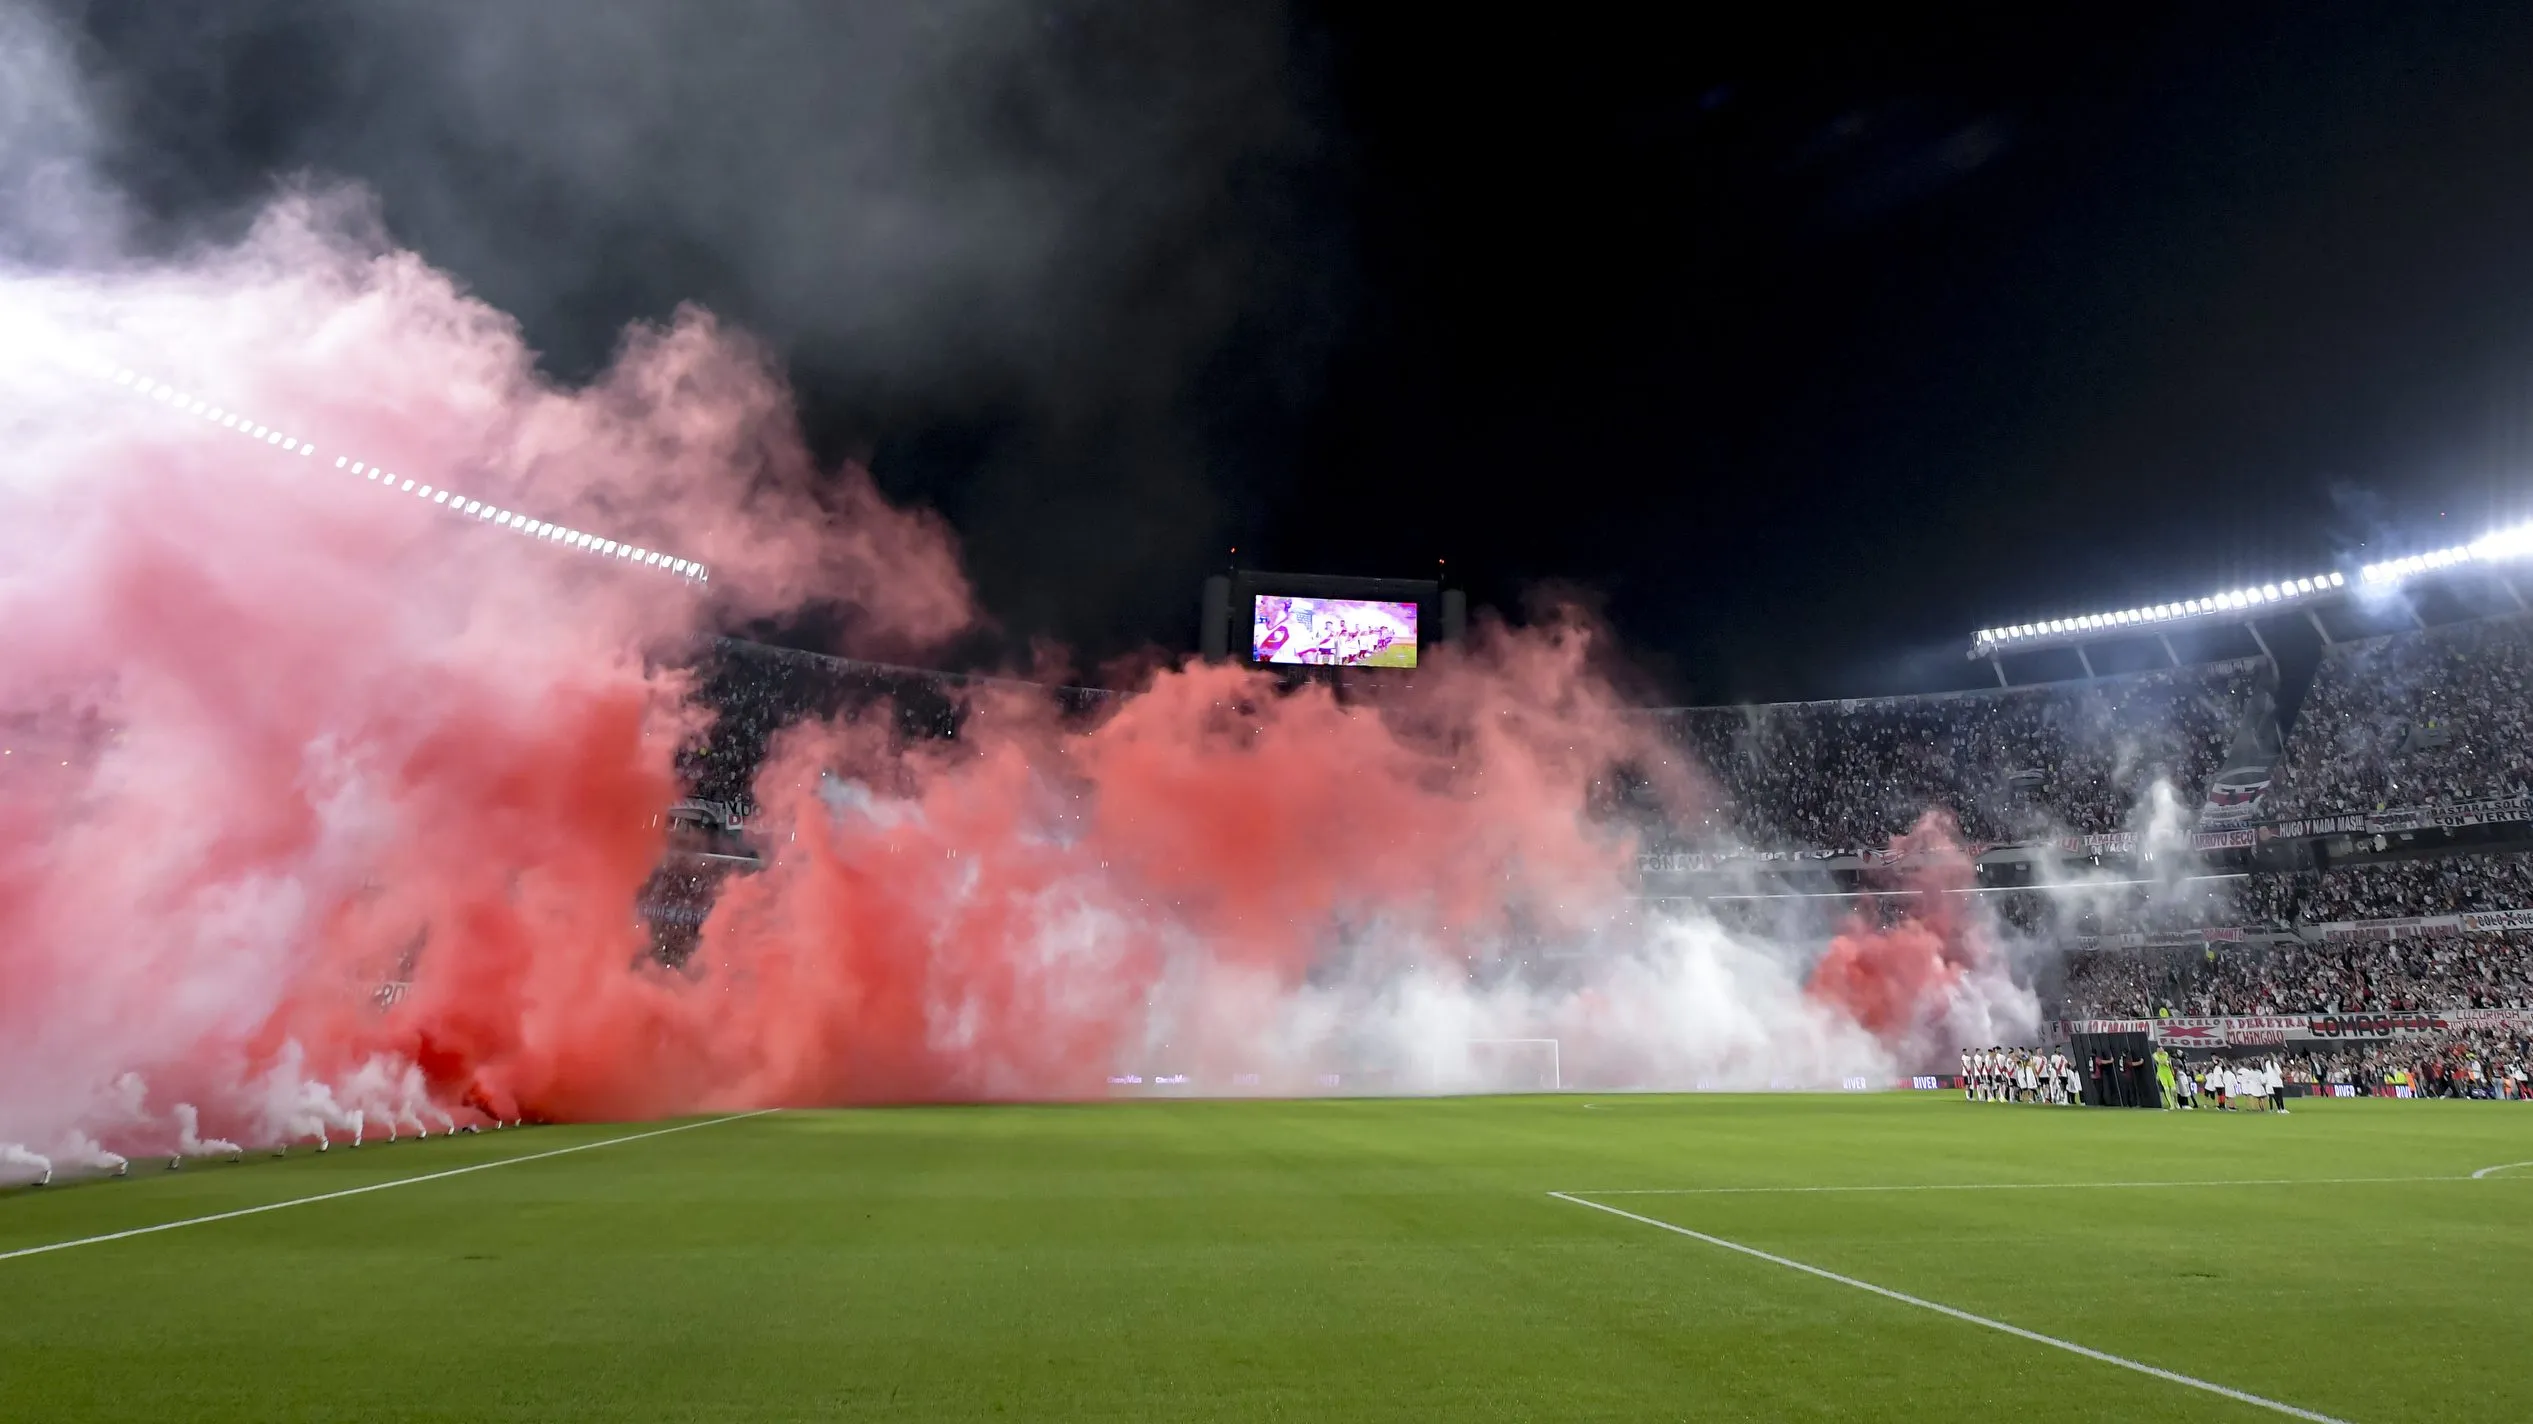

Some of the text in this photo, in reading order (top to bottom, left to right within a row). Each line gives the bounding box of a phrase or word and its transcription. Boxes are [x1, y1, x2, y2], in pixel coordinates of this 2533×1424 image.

[2434, 810, 2529, 826] CON VERTE
[2279, 822, 2302, 838] HUGO
[2304, 820, 2311, 835] Y
[2312, 818, 2335, 834] NADA
[2337, 815, 2364, 832] MAS!!!
[2229, 830, 2254, 847] SECO
[2477, 914, 2503, 927] COLO
[2156, 1018, 2219, 1026] MARCELO
[2159, 1037, 2223, 1046] FLORES
[1843, 1076, 1867, 1089] RIVER
[1912, 1076, 1938, 1089] RIVER
